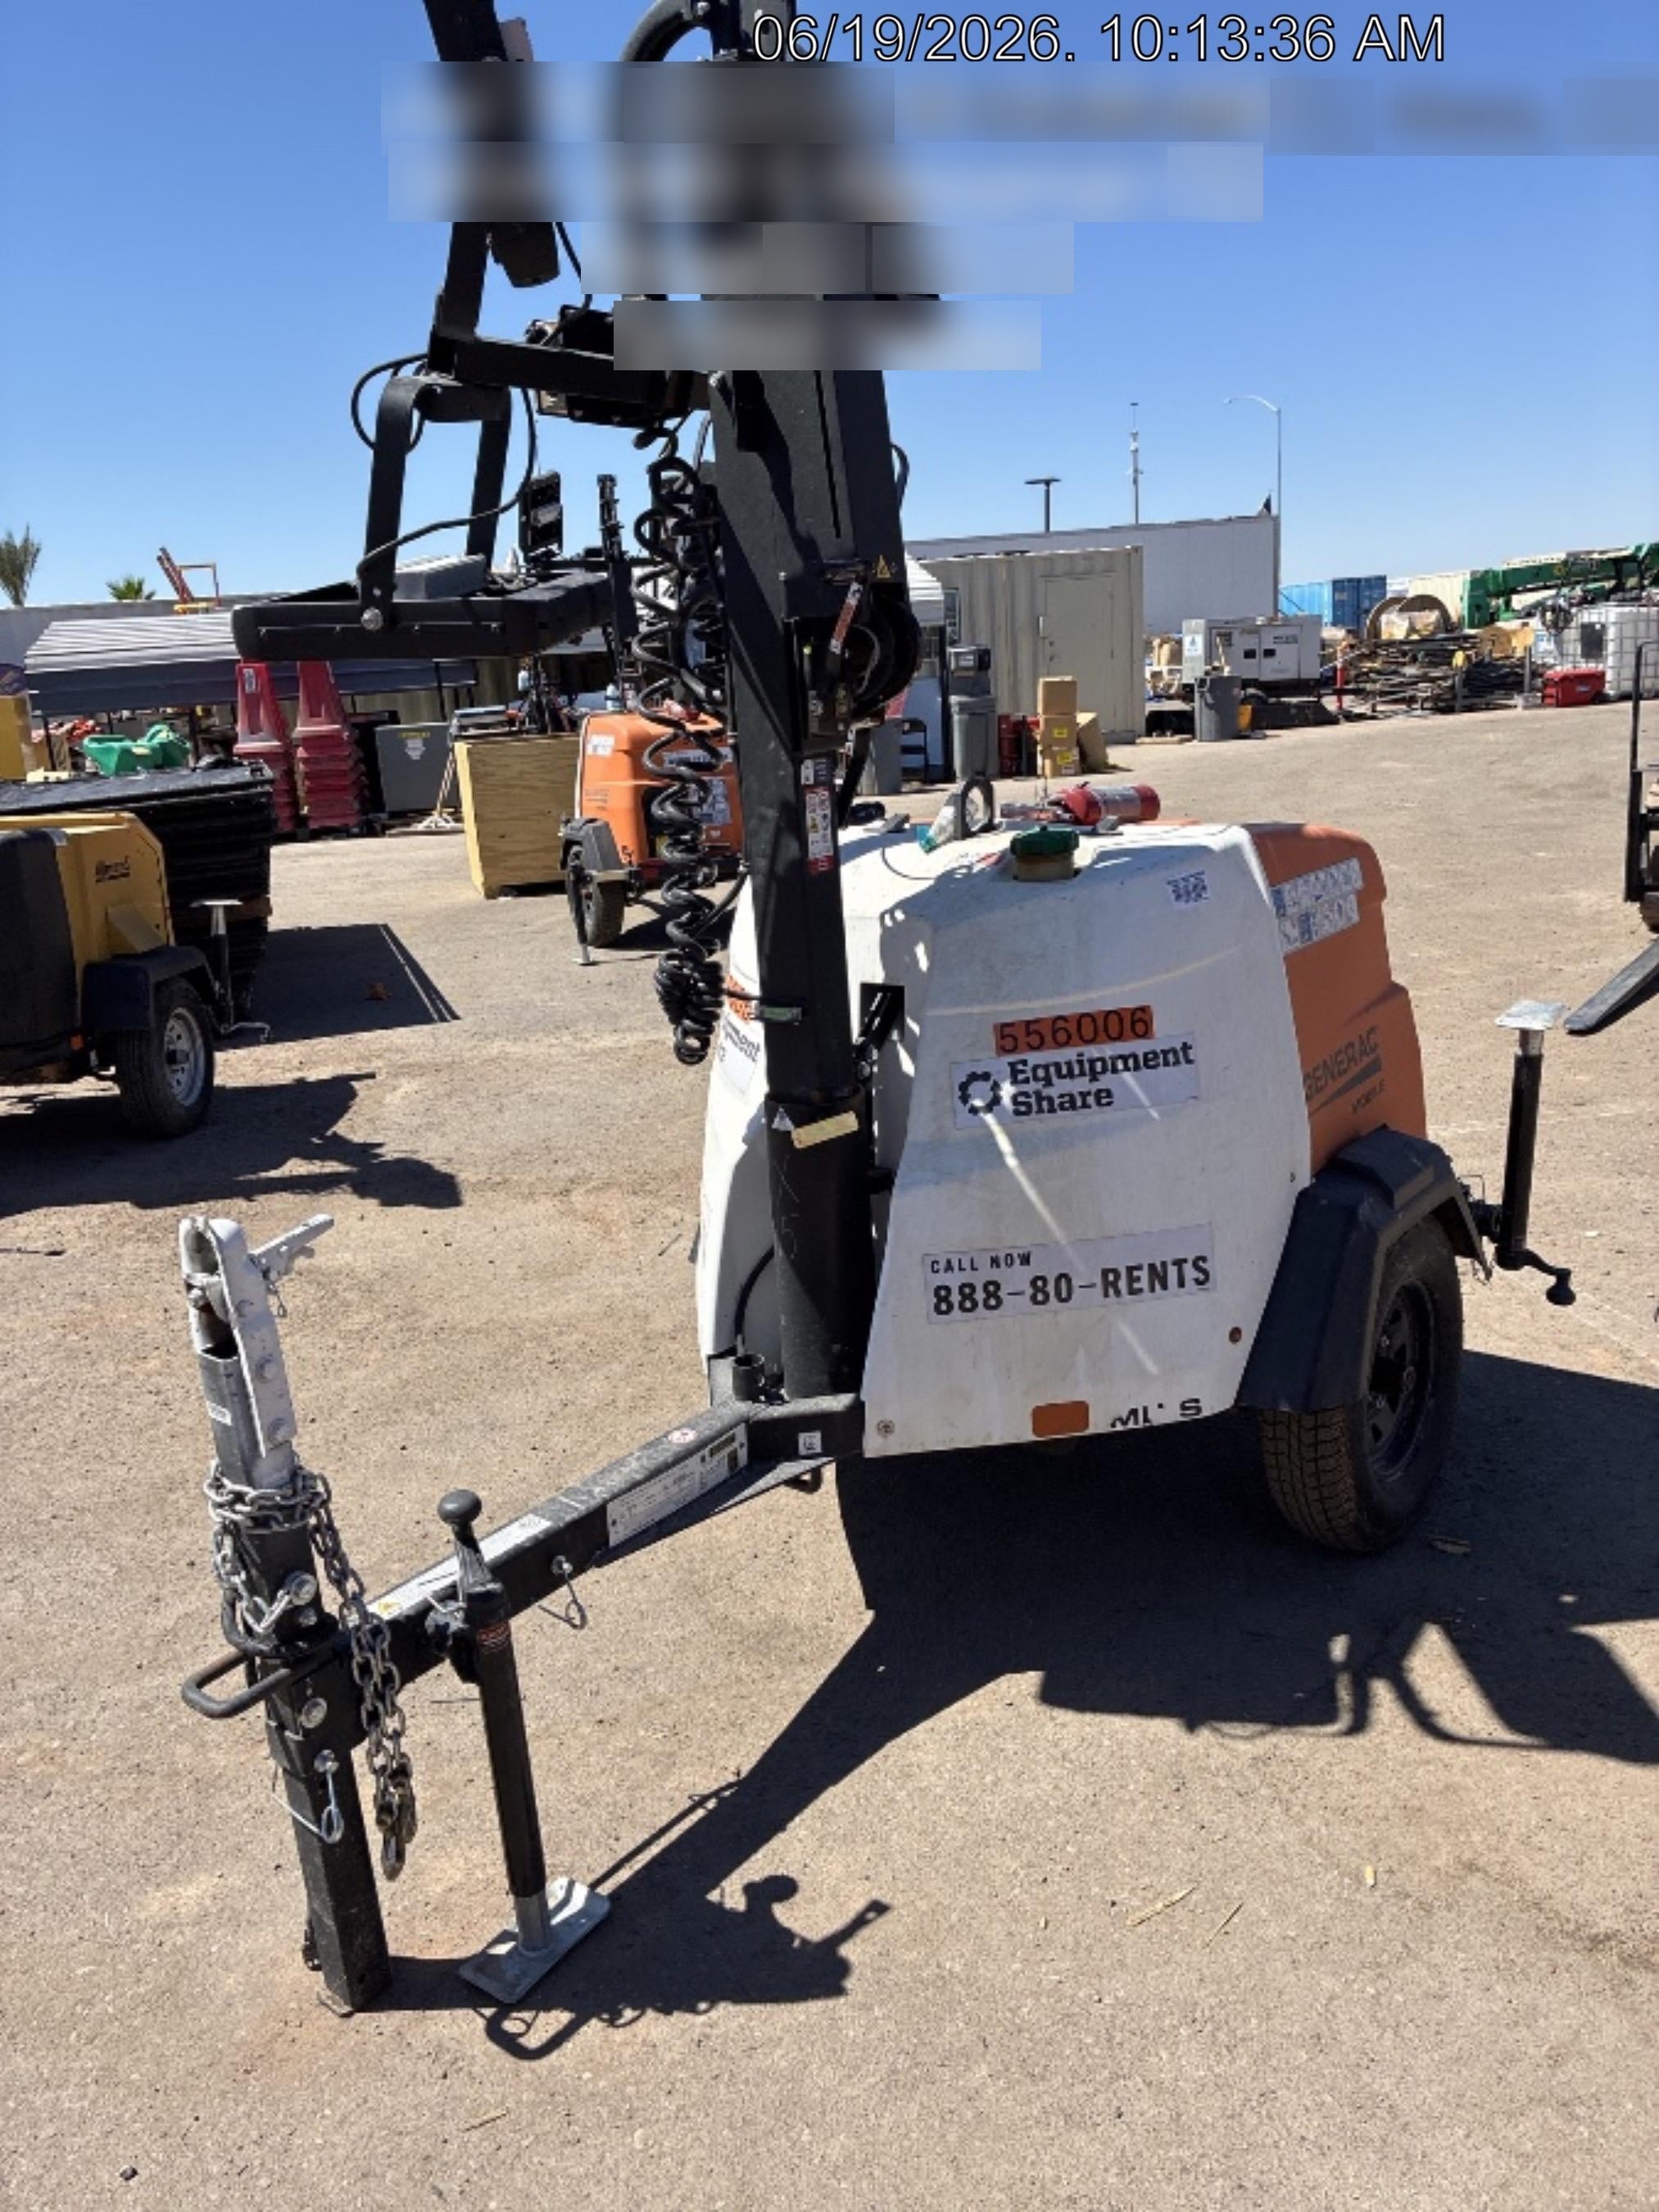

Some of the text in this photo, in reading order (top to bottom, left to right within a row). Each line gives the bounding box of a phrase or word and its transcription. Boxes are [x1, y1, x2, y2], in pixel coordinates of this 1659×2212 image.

[999, 1006, 1149, 1054] 556006
[1008, 1041, 1195, 1087] Equipment
[1012, 1087, 1113, 1117] Share
[931, 1252, 1031, 1274] CALL NOW
[933, 1255, 1211, 1316] 888-80-RENTS
